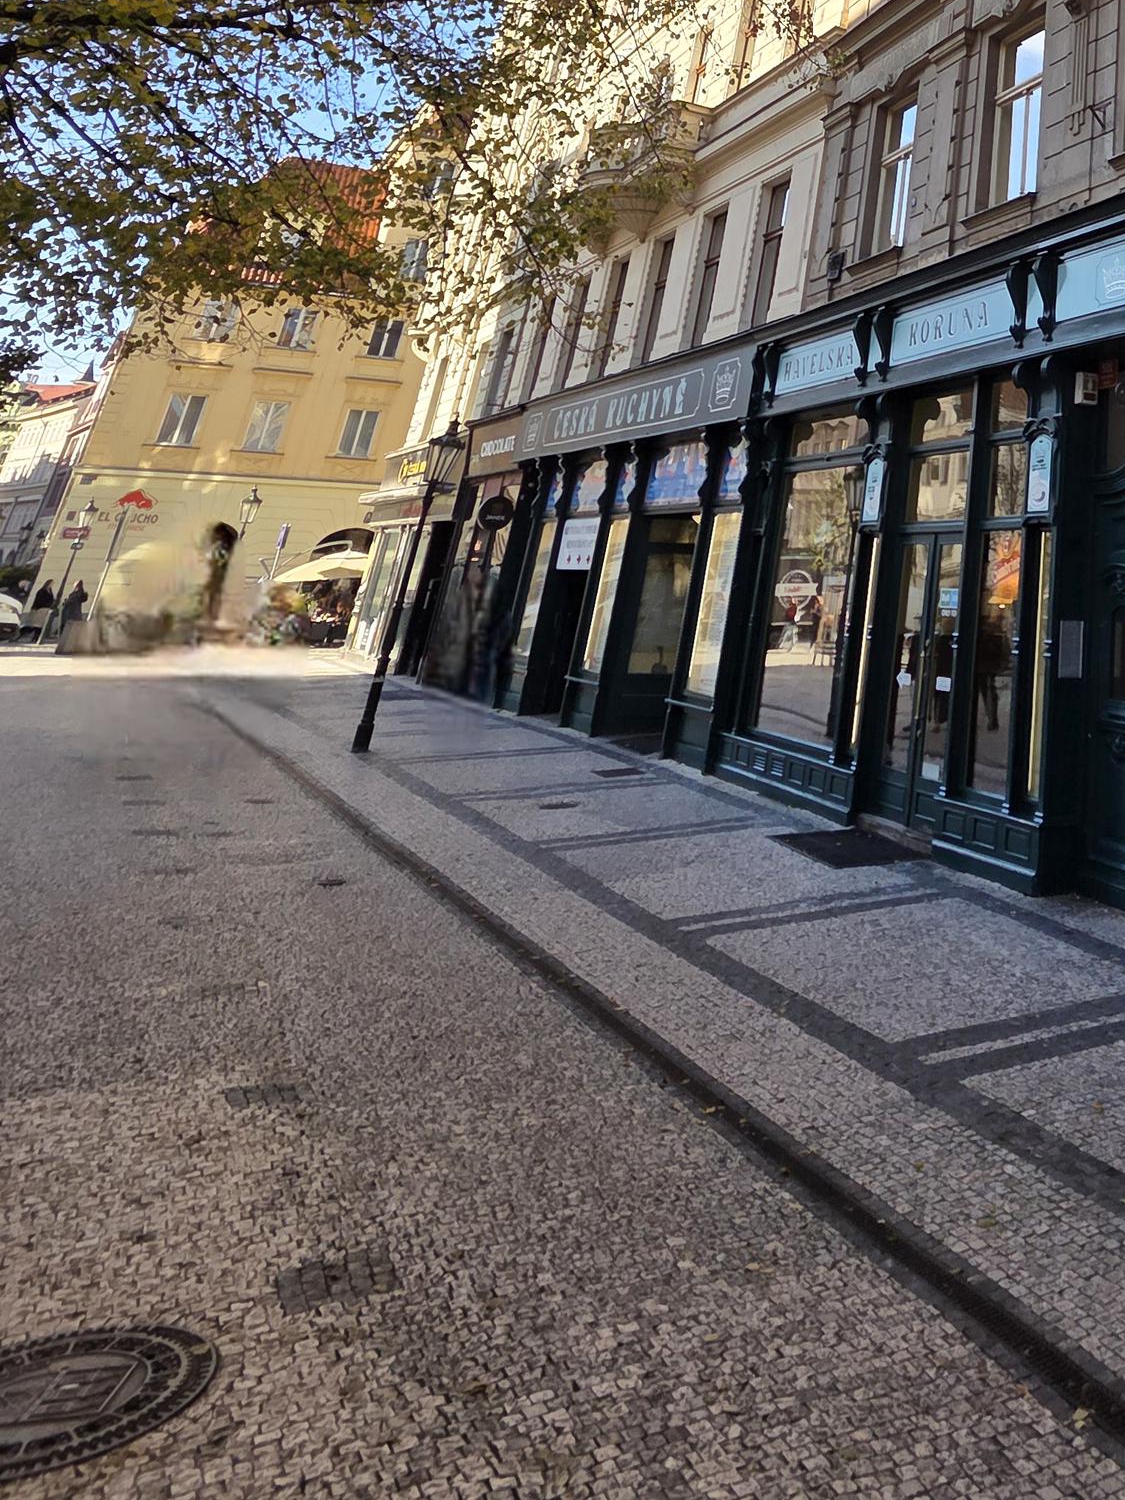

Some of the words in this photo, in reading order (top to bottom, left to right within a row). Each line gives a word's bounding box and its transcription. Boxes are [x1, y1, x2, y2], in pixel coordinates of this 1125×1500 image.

[907, 301, 990, 348] KORUNA
[553, 400, 598, 439] ČESKÁ
[605, 377, 688, 429] KUCHYNĚ
[97, 511, 110, 522] EL
